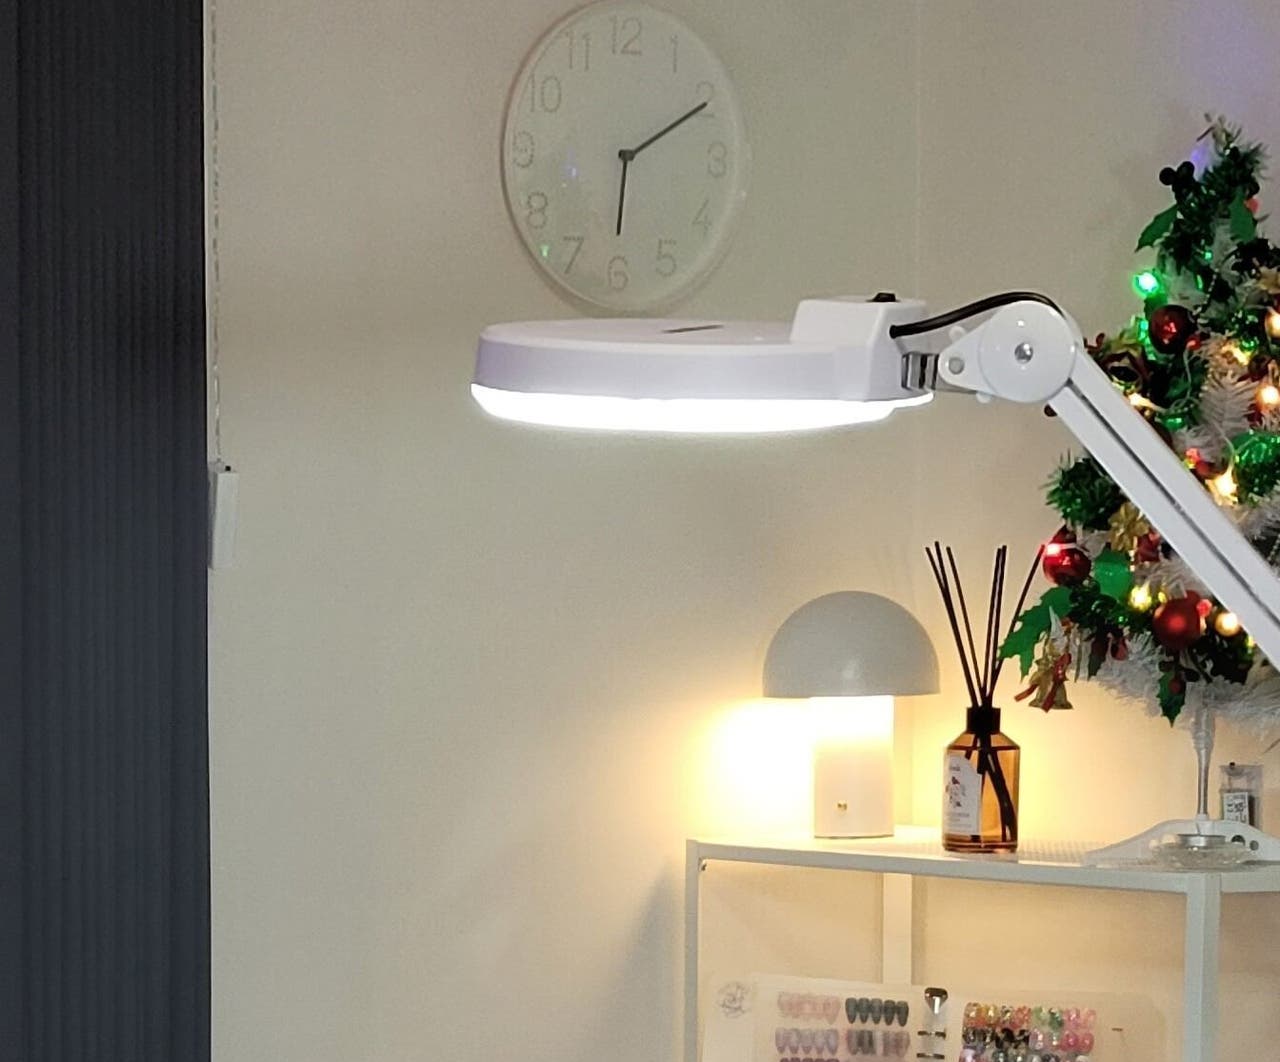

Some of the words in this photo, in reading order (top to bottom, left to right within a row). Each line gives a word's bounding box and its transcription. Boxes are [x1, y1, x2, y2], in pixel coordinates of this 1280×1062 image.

[565, 29, 591, 72] 11
[610, 17, 643, 56] 12
[671, 34, 679, 73] 1
[528, 74, 562, 114] 10
[695, 81, 715, 118] 2
[513, 131, 535, 169] 9
[707, 142, 728, 178] 3
[527, 192, 549, 230] 8
[692, 199, 713, 237] 4
[563, 236, 585, 275] 7
[608, 255, 629, 290] 6
[656, 239, 678, 277] 5
